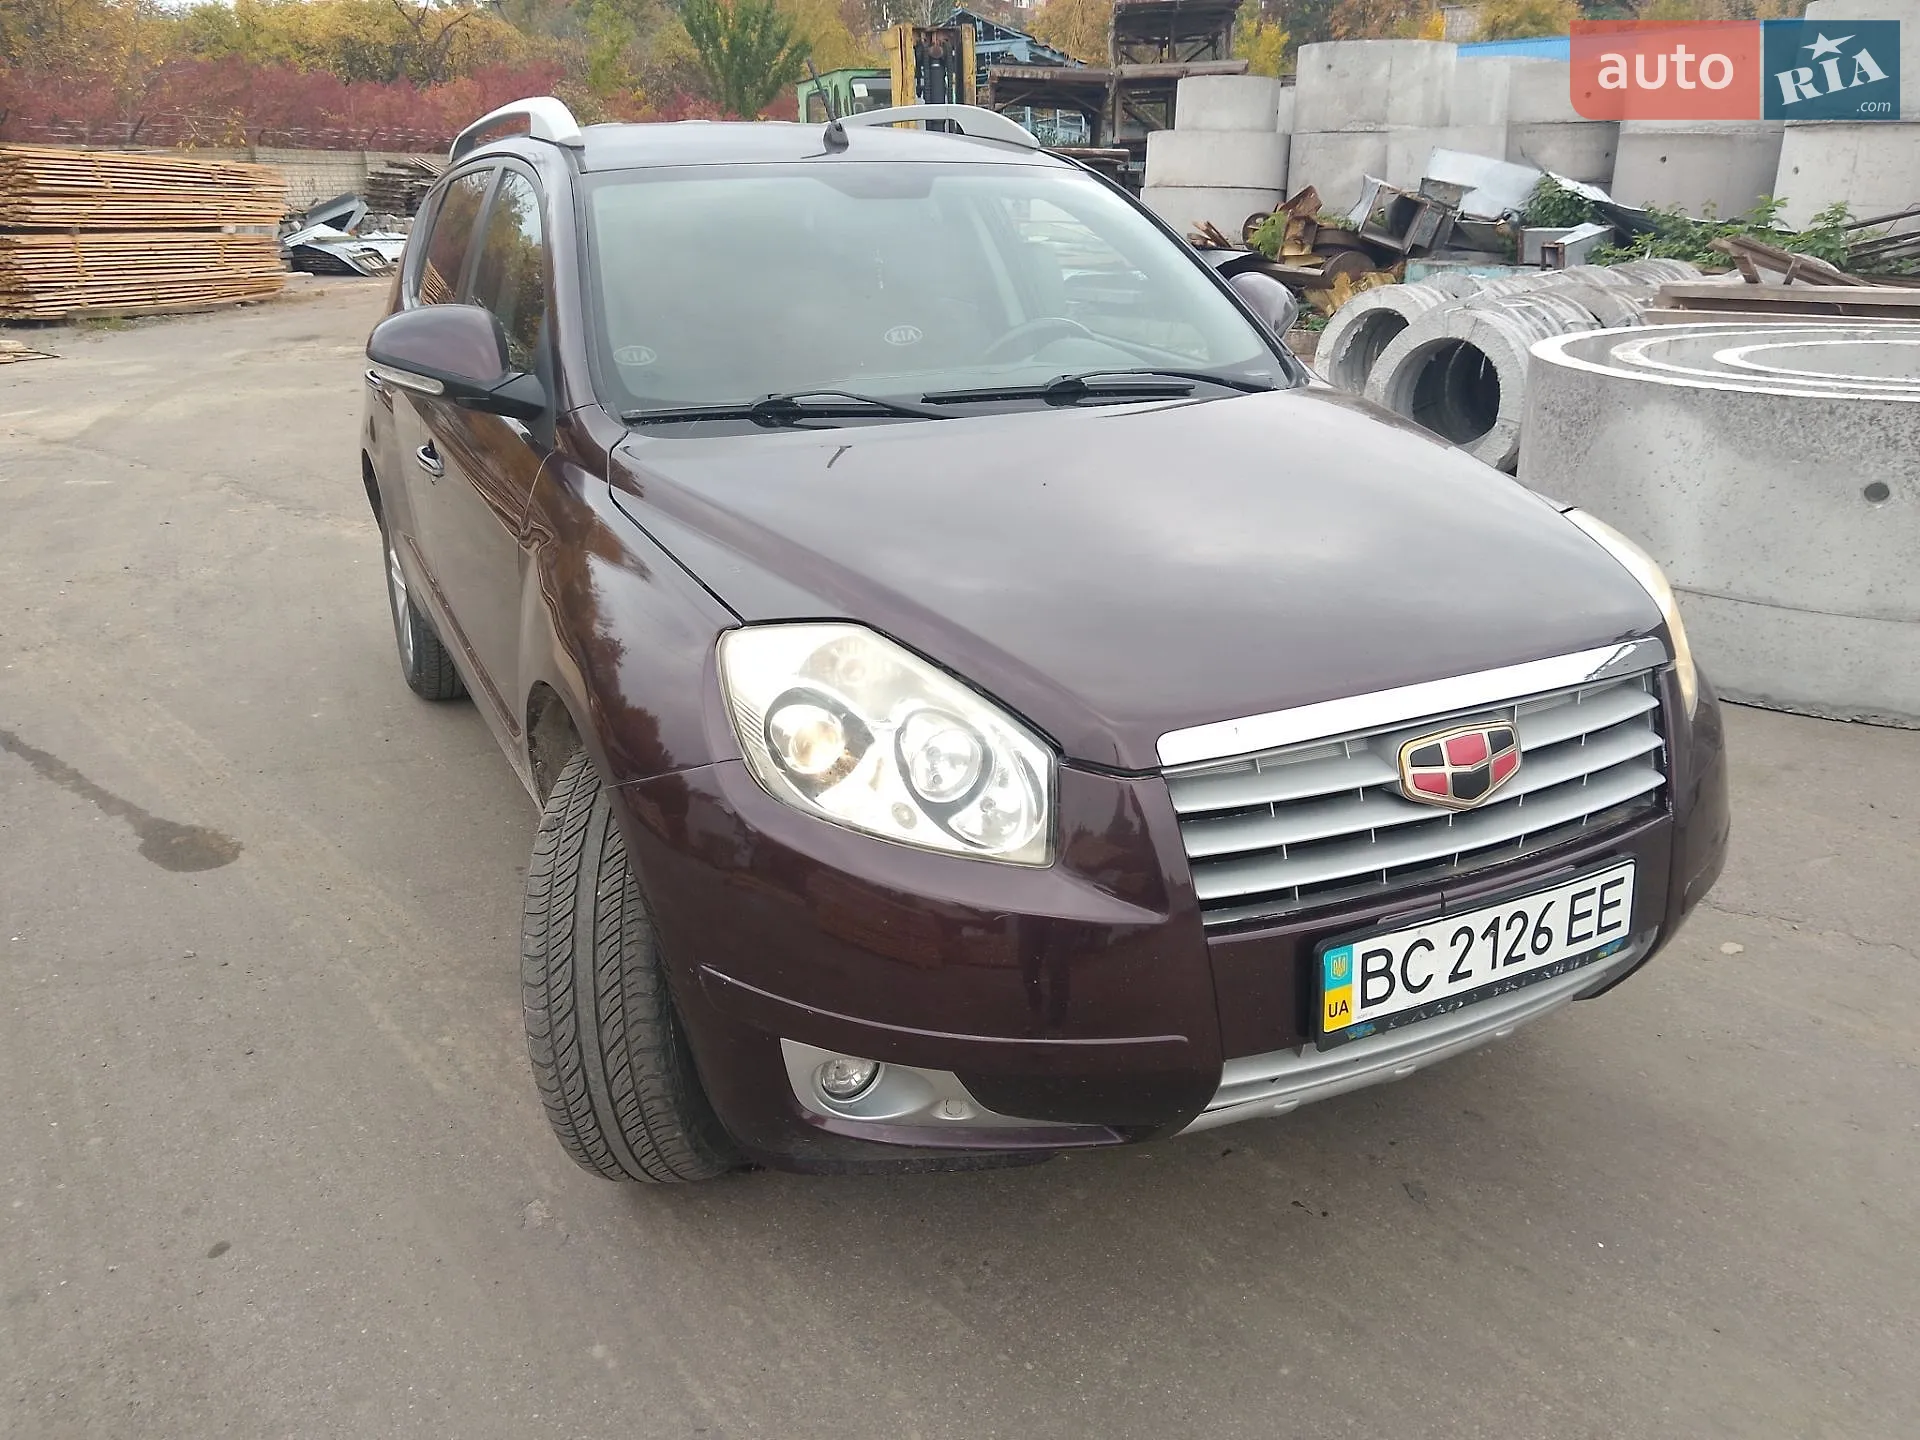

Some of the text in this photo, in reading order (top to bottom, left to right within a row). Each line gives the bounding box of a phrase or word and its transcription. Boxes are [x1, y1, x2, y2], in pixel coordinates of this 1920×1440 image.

[1360, 938, 1436, 1010] BC
[1448, 900, 1556, 984] 2126
[1566, 876, 1625, 946] EE
[1328, 999, 1349, 1018] UA
